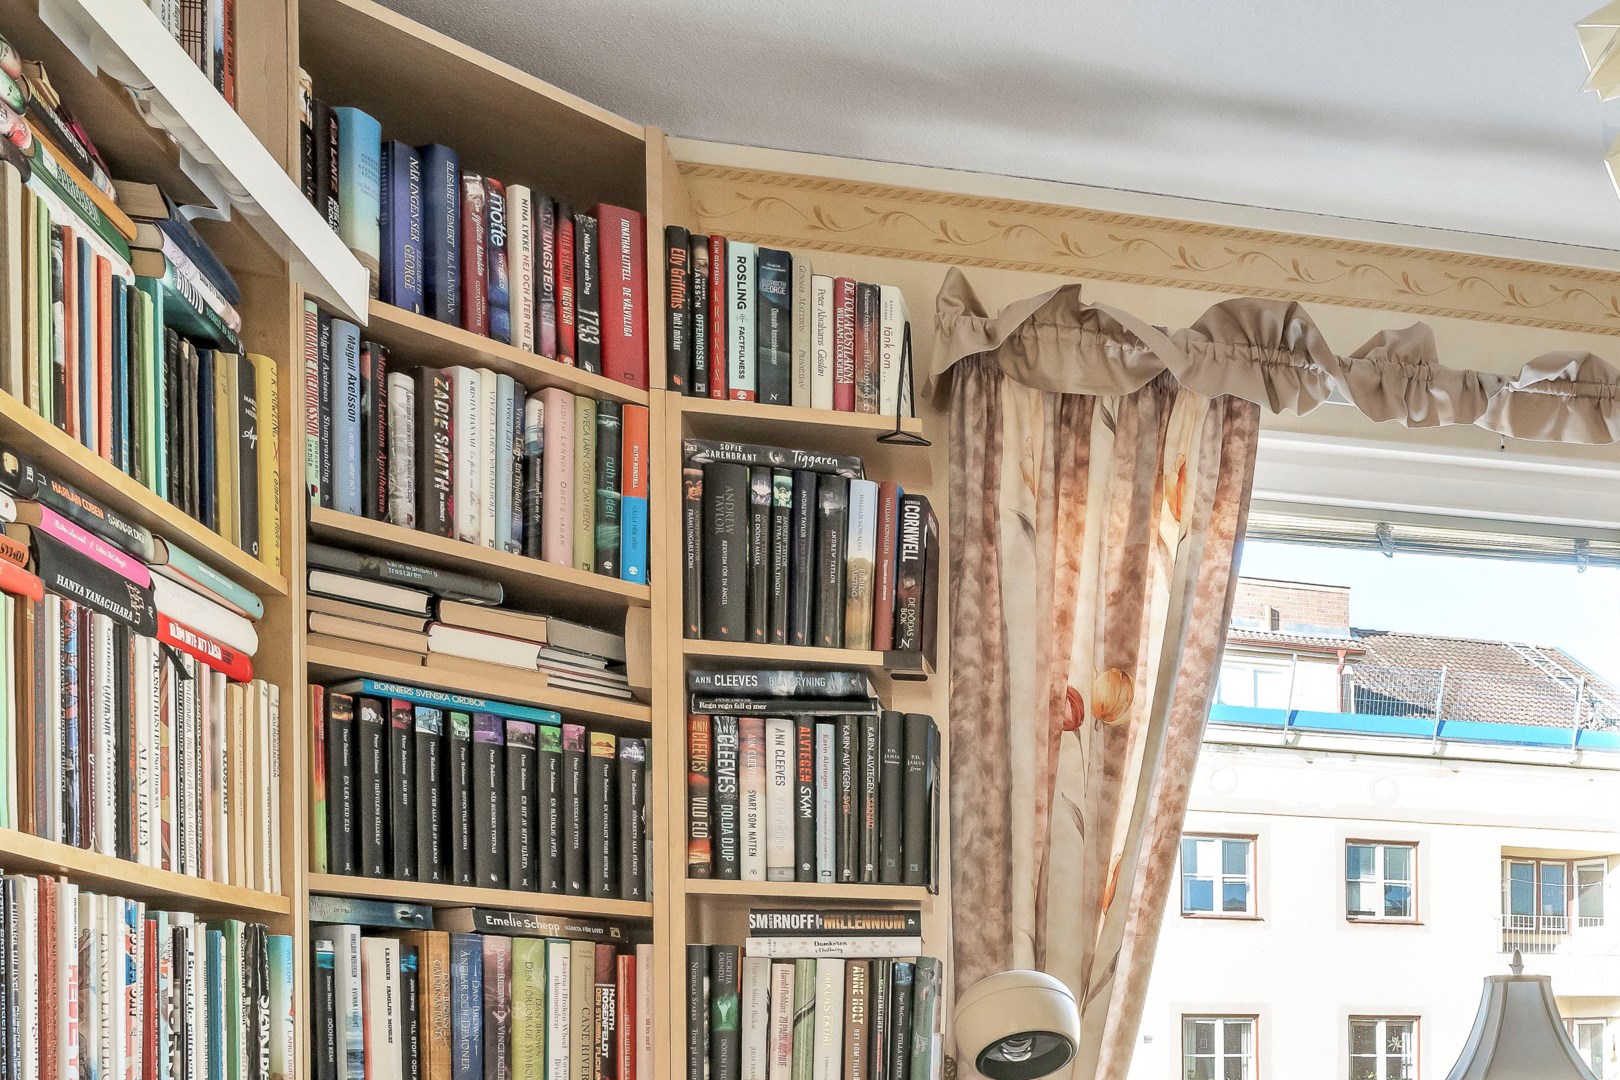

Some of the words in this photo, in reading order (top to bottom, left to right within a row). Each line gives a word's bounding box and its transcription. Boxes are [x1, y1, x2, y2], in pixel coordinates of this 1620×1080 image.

[409, 157, 418, 182] NÄR
[410, 184, 419, 218] INGEN
[411, 219, 419, 242] SER
[404, 245, 415, 290] GEORGE
[671, 248, 686, 266] Elly
[671, 268, 686, 309] Griffiths
[737, 256, 746, 310] ROSLING
[577, 309, 600, 344] 1793
[884, 326, 895, 348] tänk
[345, 335, 355, 371] Majgull
[884, 353, 890, 368] om
[347, 373, 355, 422] Axelsson
[705, 450, 756, 461] SARENBRANT
[720, 444, 742, 452] SOFIE
[792, 450, 838, 468] Tiggaren
[52, 480, 81, 509] HARLAN
[83, 500, 104, 519] COBEN
[606, 482, 615, 518] rendell
[903, 506, 920, 562] CORNWELL
[715, 675, 758, 686] CLEEVES
[374, 682, 413, 696] BONNIERS
[415, 688, 450, 701] SVENSKA
[452, 695, 486, 707] ORDBOK
[775, 728, 785, 745] ANN
[692, 733, 707, 772] CLEEVES
[718, 735, 735, 793] CLEEVES
[139, 743, 147, 790] ALEX
[775, 747, 785, 786] CLEEVES
[692, 797, 707, 817] VILD
[747, 790, 756, 811] SVART
[800, 786, 812, 817] SKAM
[140, 795, 149, 850] HALEY
[692, 822, 707, 837] ELD
[721, 804, 733, 836] DOLDA
[748, 813, 756, 829] SOM
[721, 839, 734, 862] DJUP
[748, 831, 757, 857] NATTEN
[486, 915, 522, 928] Emelie
[524, 917, 559, 933] Schepp
[852, 967, 863, 994] ANNE
[852, 997, 863, 1024] HOLT
